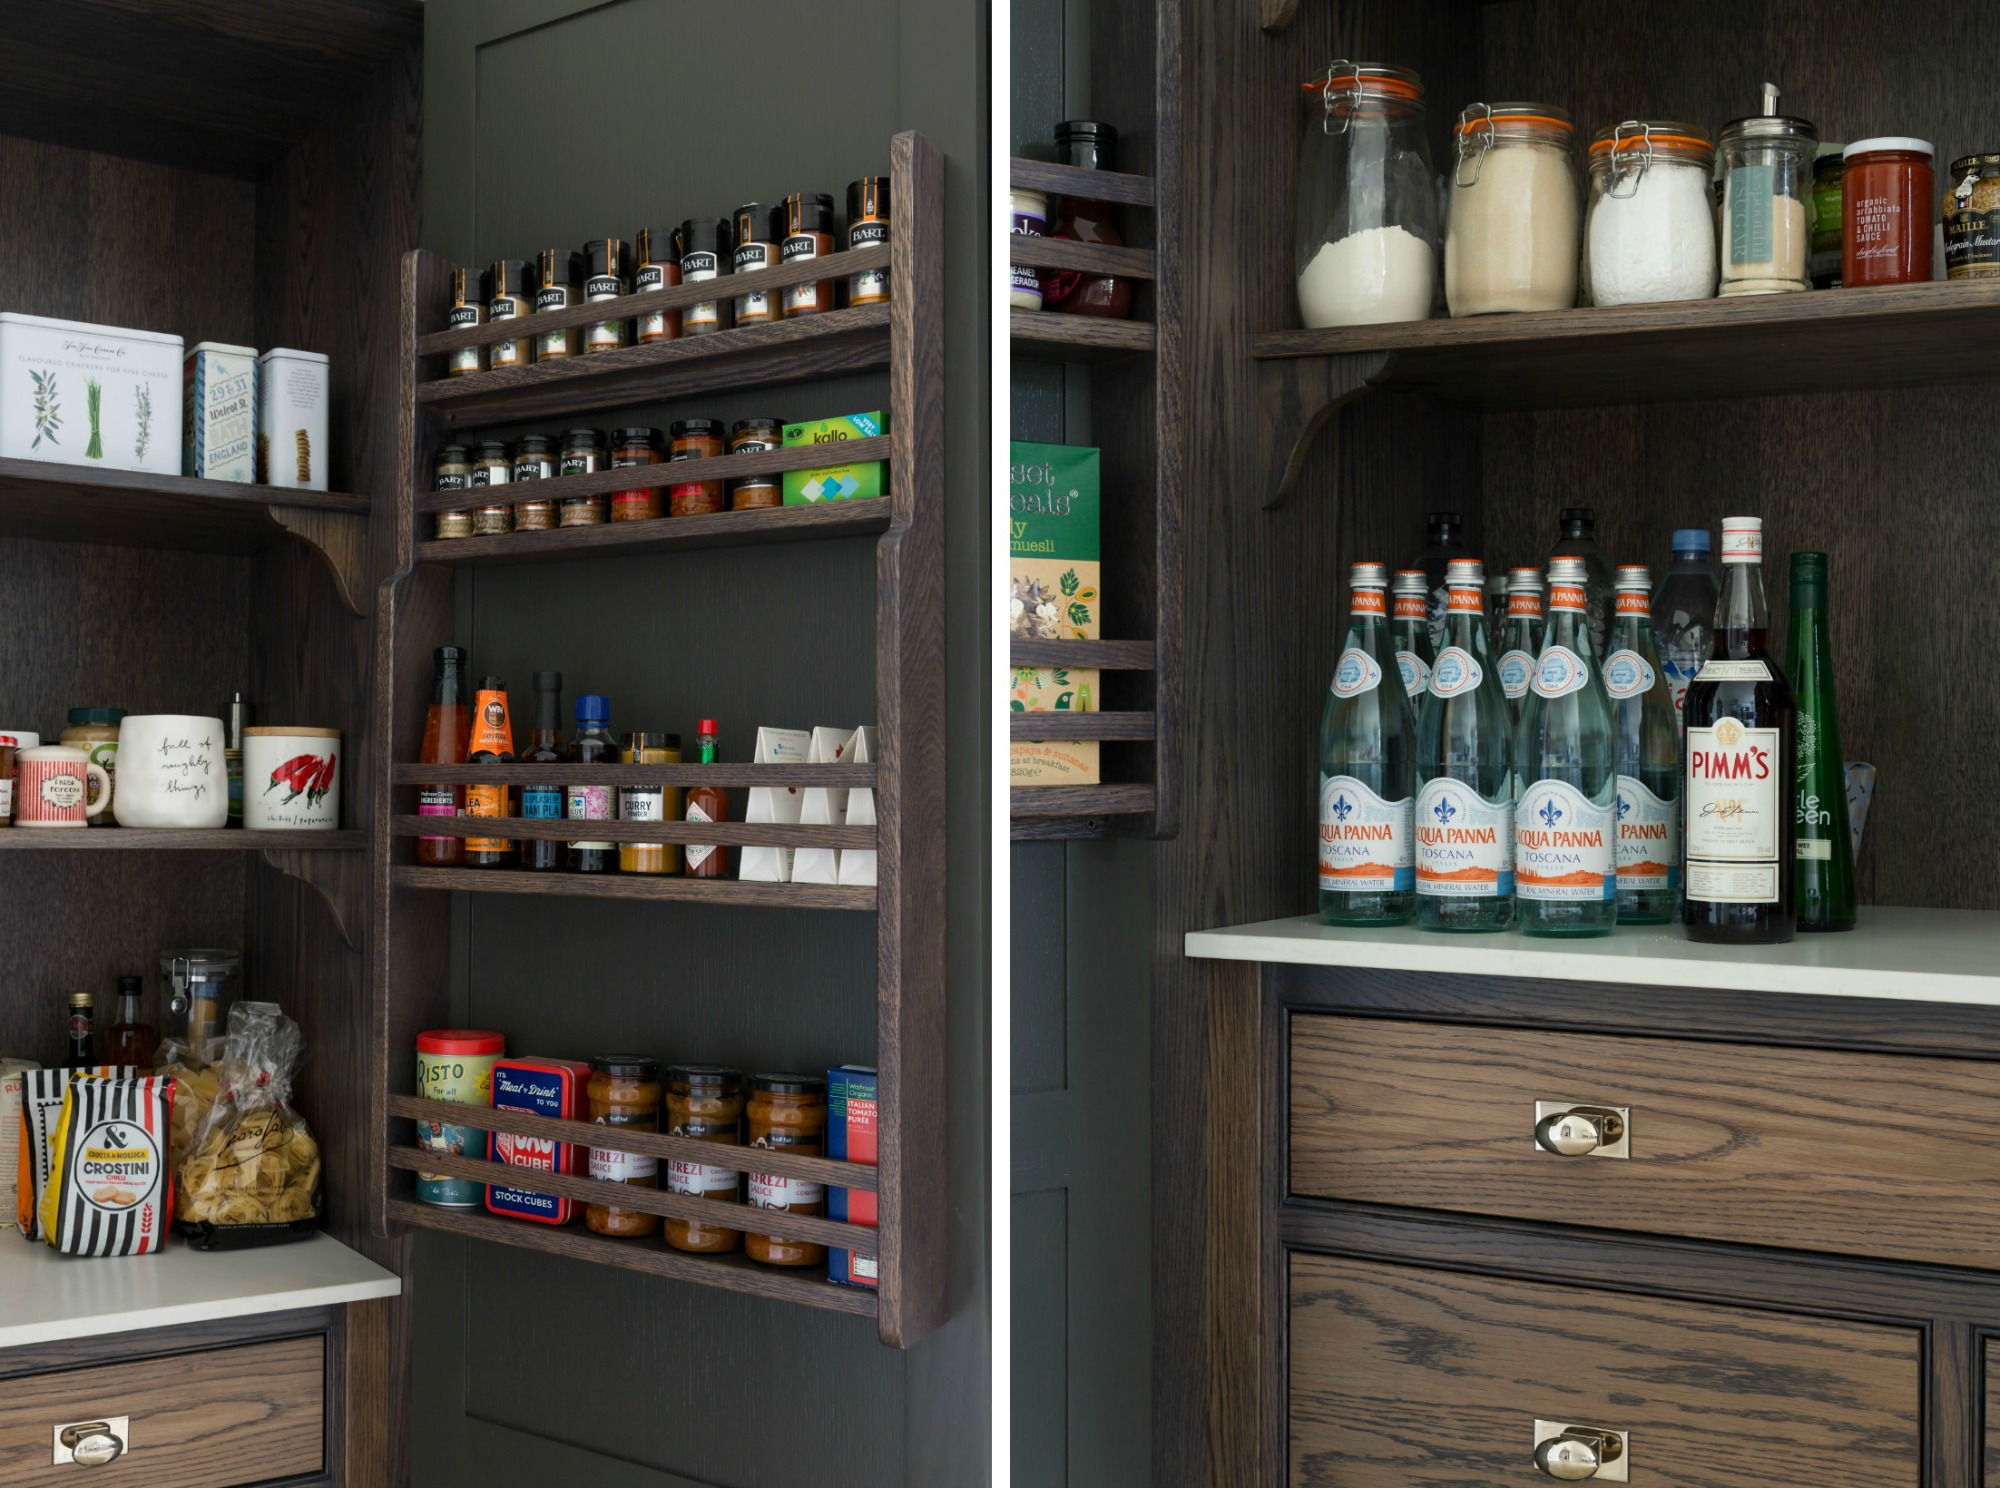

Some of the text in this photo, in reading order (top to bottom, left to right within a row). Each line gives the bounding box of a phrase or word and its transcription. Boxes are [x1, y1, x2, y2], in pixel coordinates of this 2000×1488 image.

[1856, 197, 1888, 208] organic
[1856, 204, 1900, 216] arrabbiata
[1734, 187, 1747, 258] SUGAR
[1856, 214, 1886, 225] TOMATO
[1856, 222, 1890, 234] & CHILLI
[1856, 232, 1881, 242] SAUCE
[1971, 234, 2000, 248] Mustar
[1010, 276, 1040, 289] SERADISH
[18, 354, 62, 367] FLAVOURED
[66, 362, 104, 372] CRACKERS
[123, 368, 140, 376] FINE
[142, 370, 168, 380] CHEESE
[209, 387, 224, 402] 29
[235, 378, 248, 392] 31
[852, 416, 865, 428] LOW
[862, 416, 876, 430] VERY
[209, 418, 248, 445] BATH
[814, 430, 848, 444] kallo
[209, 441, 248, 464] ENGLAND
[1010, 461, 1055, 486] set
[1010, 488, 1070, 516] eals
[1354, 598, 1380, 607] PANNA
[1452, 595, 1480, 605] PANNA
[1557, 592, 1584, 603] PANNA
[1626, 598, 1650, 608] PANNA
[1402, 602, 1426, 612] PANNA
[1516, 601, 1540, 610] PANNA
[488, 704, 503, 714] WIN
[158, 737, 212, 754] full of
[1044, 746, 1052, 757] &
[1052, 750, 1088, 772] sultanas
[1692, 745, 1770, 780] PIMM'S
[161, 755, 212, 776] naughty
[1032, 757, 1070, 774] breakfast
[164, 780, 206, 800] things
[467, 798, 480, 807] EA
[528, 796, 552, 804] SPLASH
[624, 800, 652, 810] CURRY
[542, 804, 560, 816] PLA
[1344, 824, 1392, 840] PANNA
[1446, 826, 1496, 844] PANNA
[1621, 822, 1668, 840] PANNA
[1552, 830, 1603, 848] PANNA
[1322, 844, 1370, 856] TOSCANA
[1421, 847, 1474, 860] TOSCANA
[1616, 844, 1648, 855] CANA
[1524, 852, 1581, 864] TOSCANA
[1332, 878, 1358, 886] MINERAL
[1434, 882, 1462, 890] MINERAL
[1538, 887, 1568, 896] MINERAL
[434, 1086, 444, 1094] For
[848, 1082, 876, 1092] Waitrose
[848, 1090, 874, 1098] Organic
[546, 1100, 559, 1108] YOU
[848, 1100, 875, 1110] ITALIAN
[848, 1108, 878, 1118] TOMATO
[848, 1116, 869, 1124] PURÉE
[590, 1148, 625, 1164] LFREZI
[83, 1161, 150, 1175] CROSTINI
[591, 1162, 612, 1173] SAUCE
[668, 1160, 703, 1176] LFREZI
[750, 1172, 788, 1188] LFREZI
[751, 1184, 774, 1196] SAUCE
[495, 1190, 523, 1204] STOCK
[524, 1196, 553, 1209] CUBES
